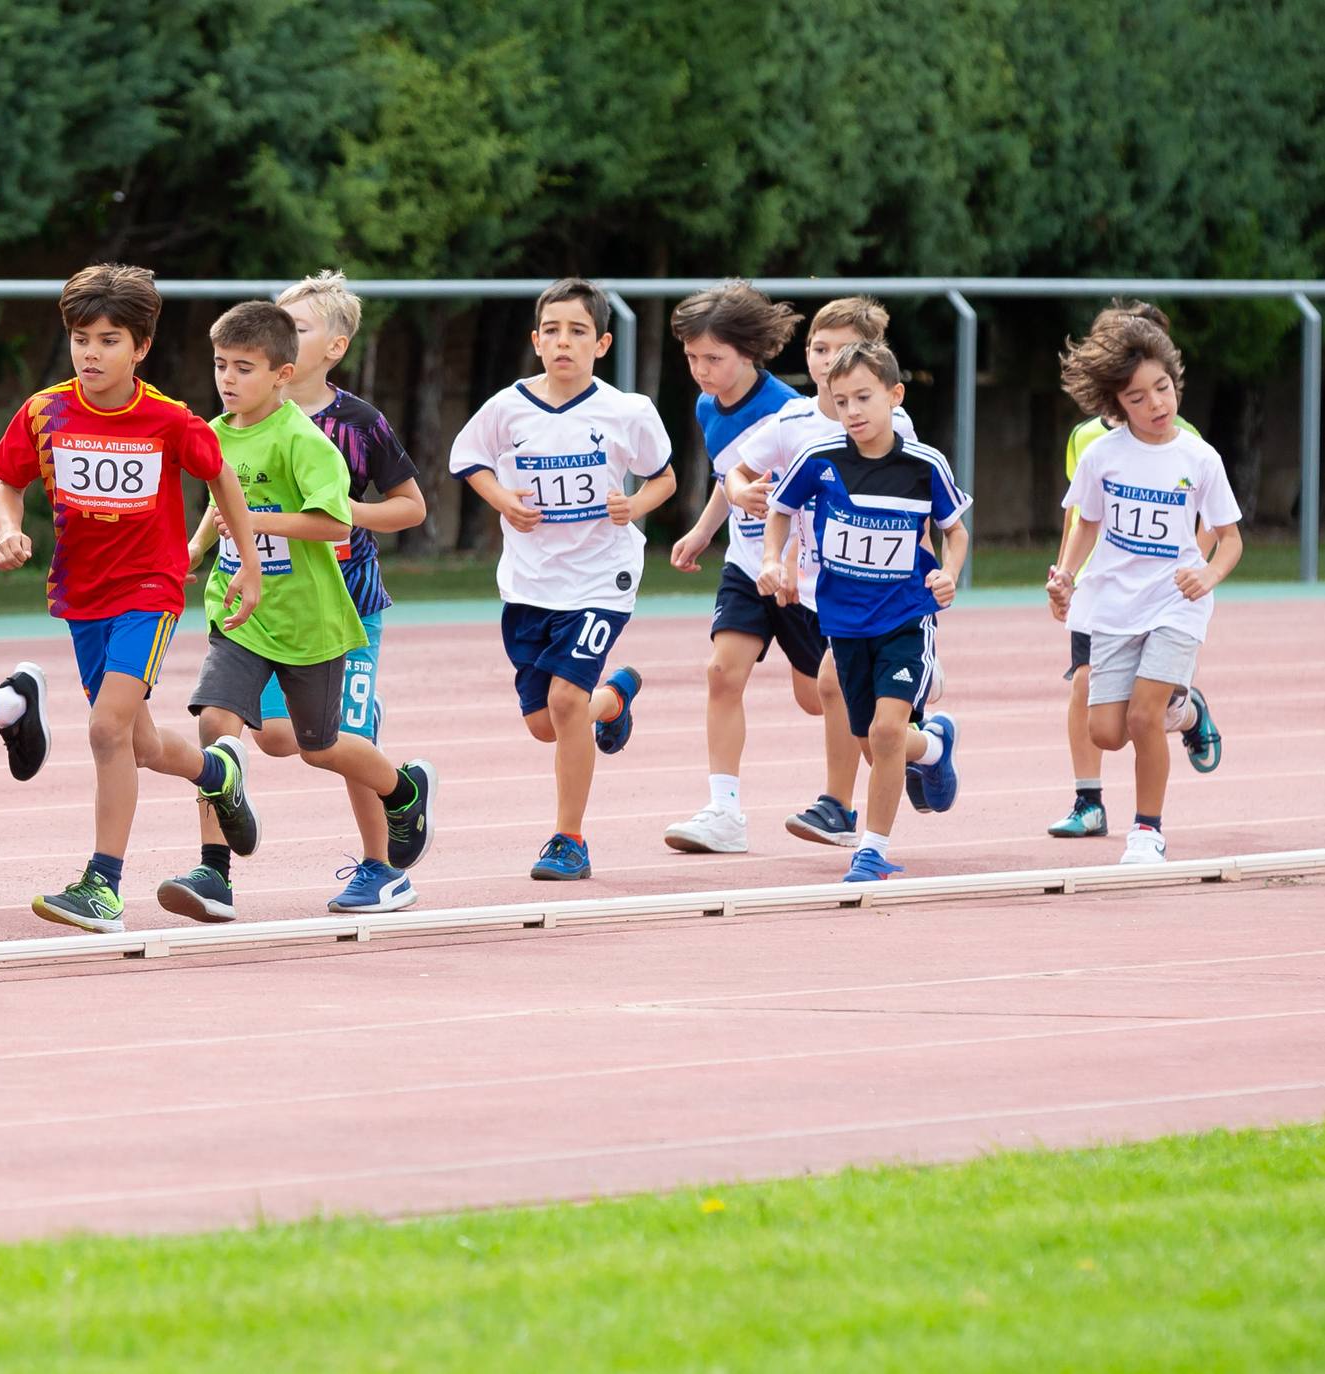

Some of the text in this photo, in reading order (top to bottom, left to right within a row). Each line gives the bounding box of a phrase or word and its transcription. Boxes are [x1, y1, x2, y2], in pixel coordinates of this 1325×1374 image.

[62, 438, 154, 452] LA RIOJA ATLETISMO
[541, 454, 600, 469] HEMAFIX
[71, 456, 144, 494] 308
[531, 473, 595, 507] 113
[1122, 486, 1180, 504] HEMAFIX
[852, 515, 911, 530] HEMAFIX
[1111, 503, 1169, 540] 115
[835, 530, 903, 567] 117
[577, 611, 611, 655] 10
[354, 661, 373, 672] STOP
[341, 673, 370, 728] 9
